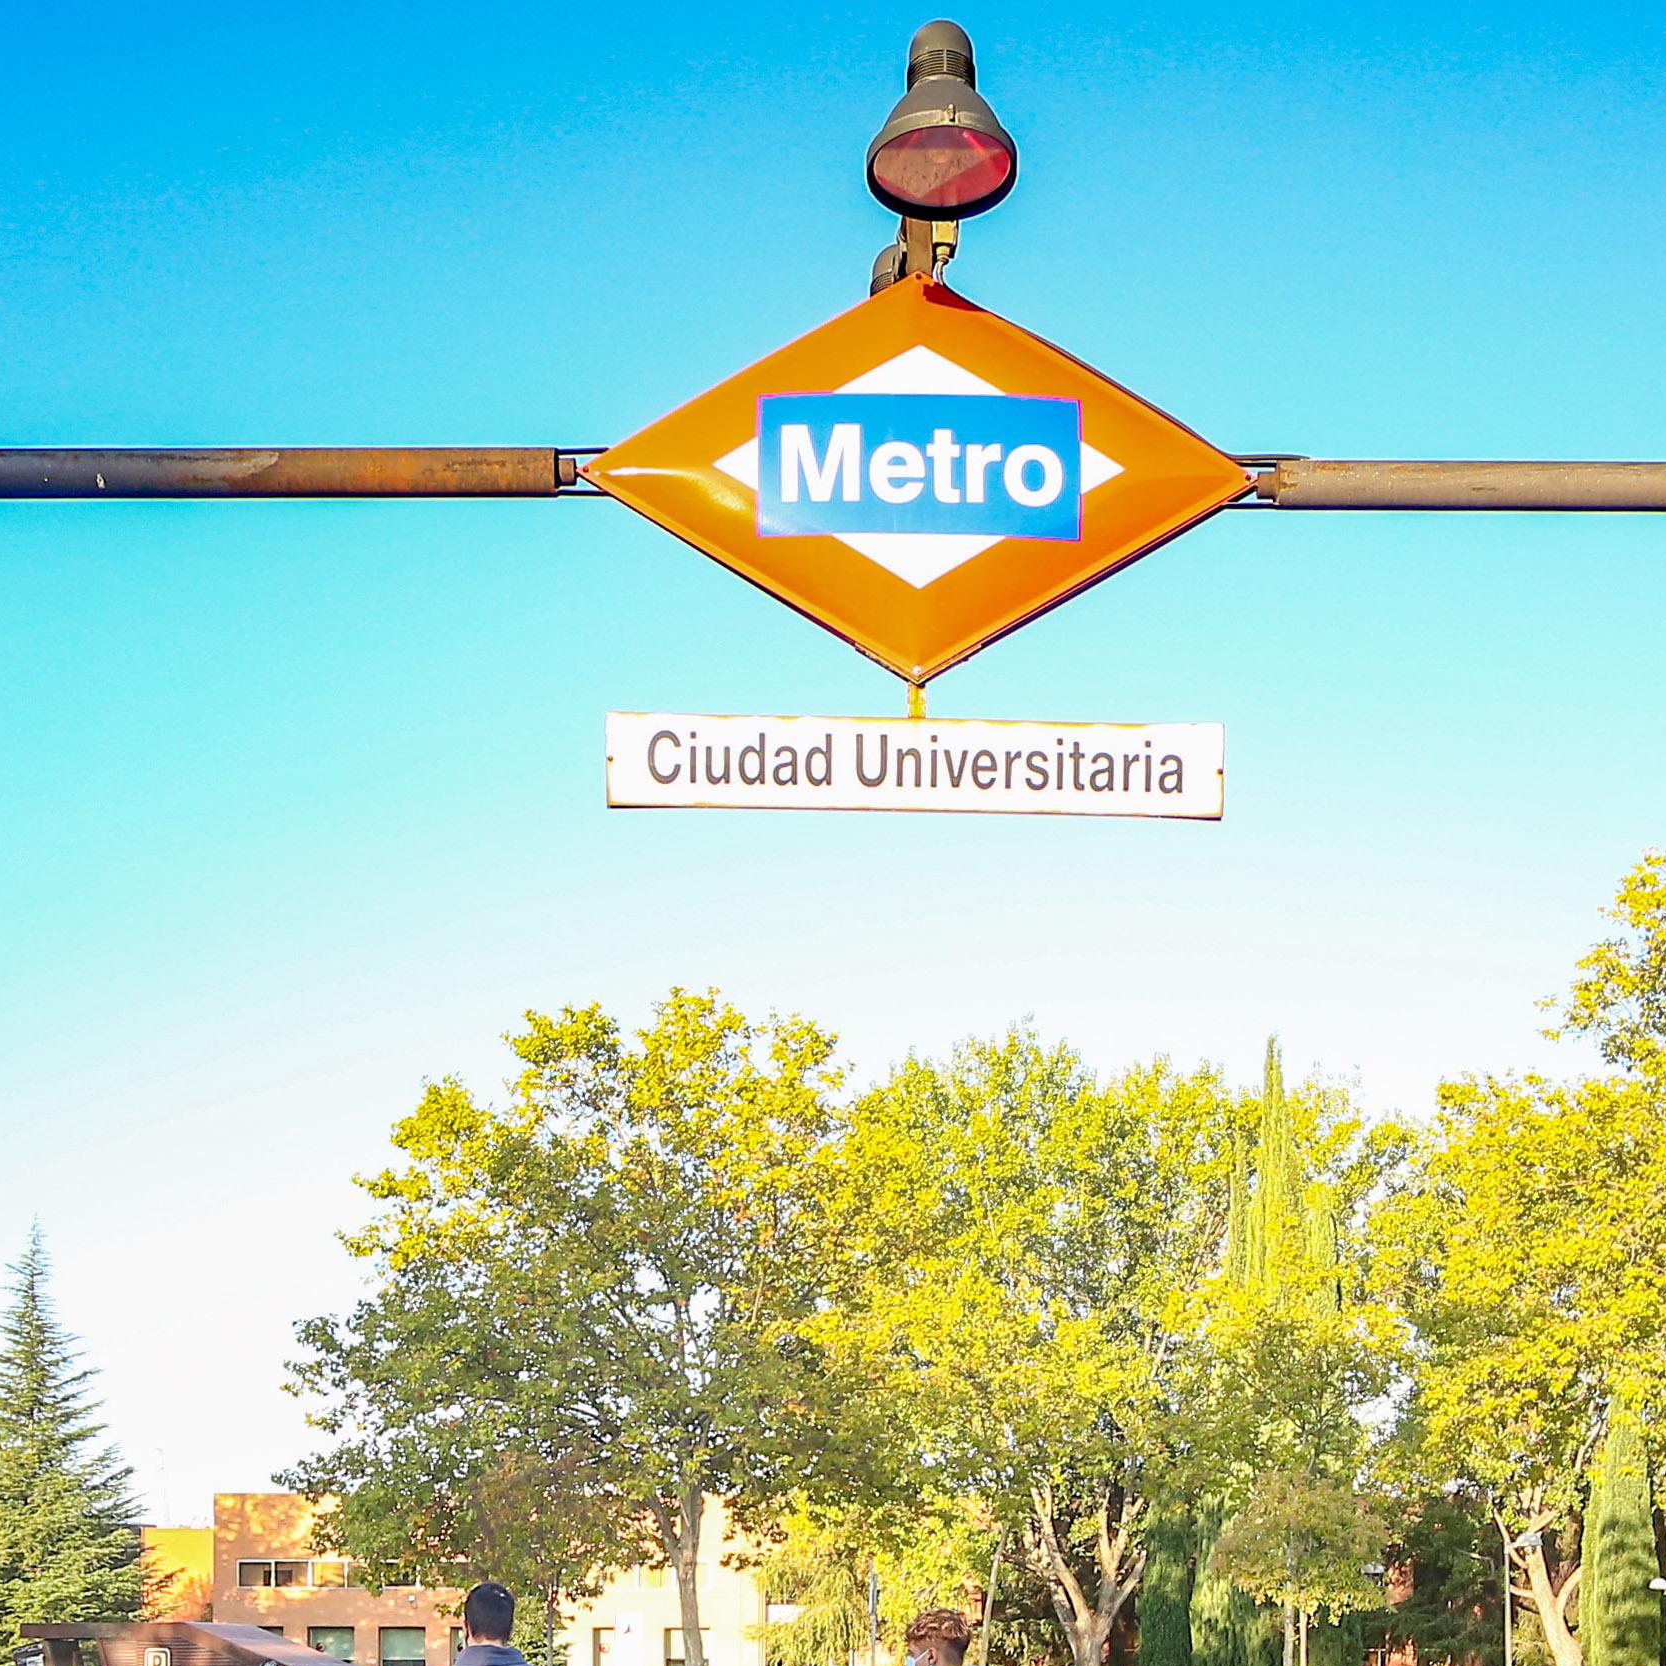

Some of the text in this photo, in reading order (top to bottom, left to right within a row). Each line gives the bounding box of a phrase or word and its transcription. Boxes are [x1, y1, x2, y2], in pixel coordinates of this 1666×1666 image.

[780, 423, 1064, 508] Metro
[646, 729, 1185, 795] Ciudad Universitaria
